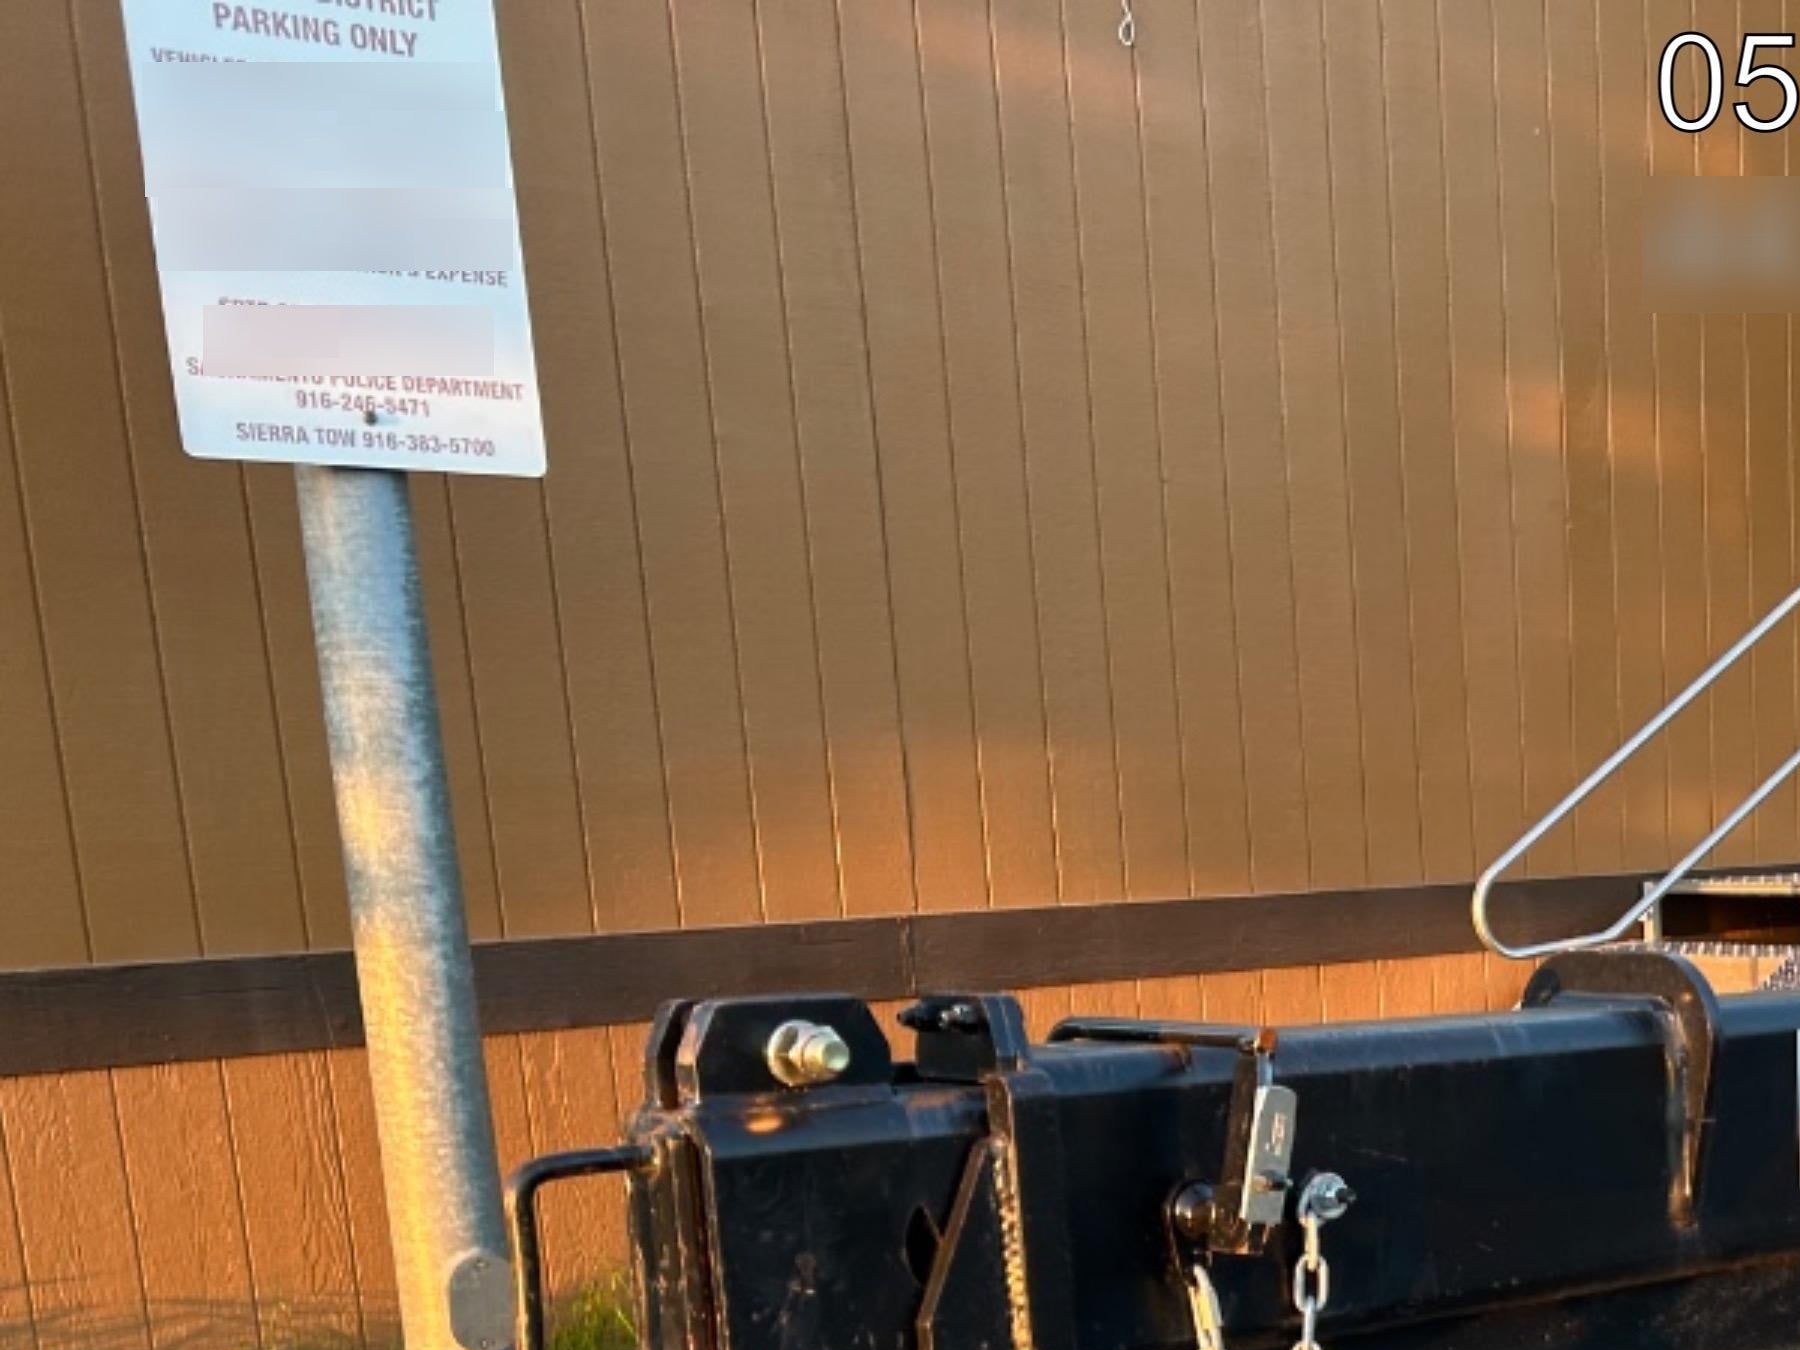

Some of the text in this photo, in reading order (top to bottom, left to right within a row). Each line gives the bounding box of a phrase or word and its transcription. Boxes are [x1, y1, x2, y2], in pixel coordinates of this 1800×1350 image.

[213, 2, 418, 57] PARKING ONLY
[235, 422, 310, 445] SIERRA
[315, 427, 357, 448] TOW
